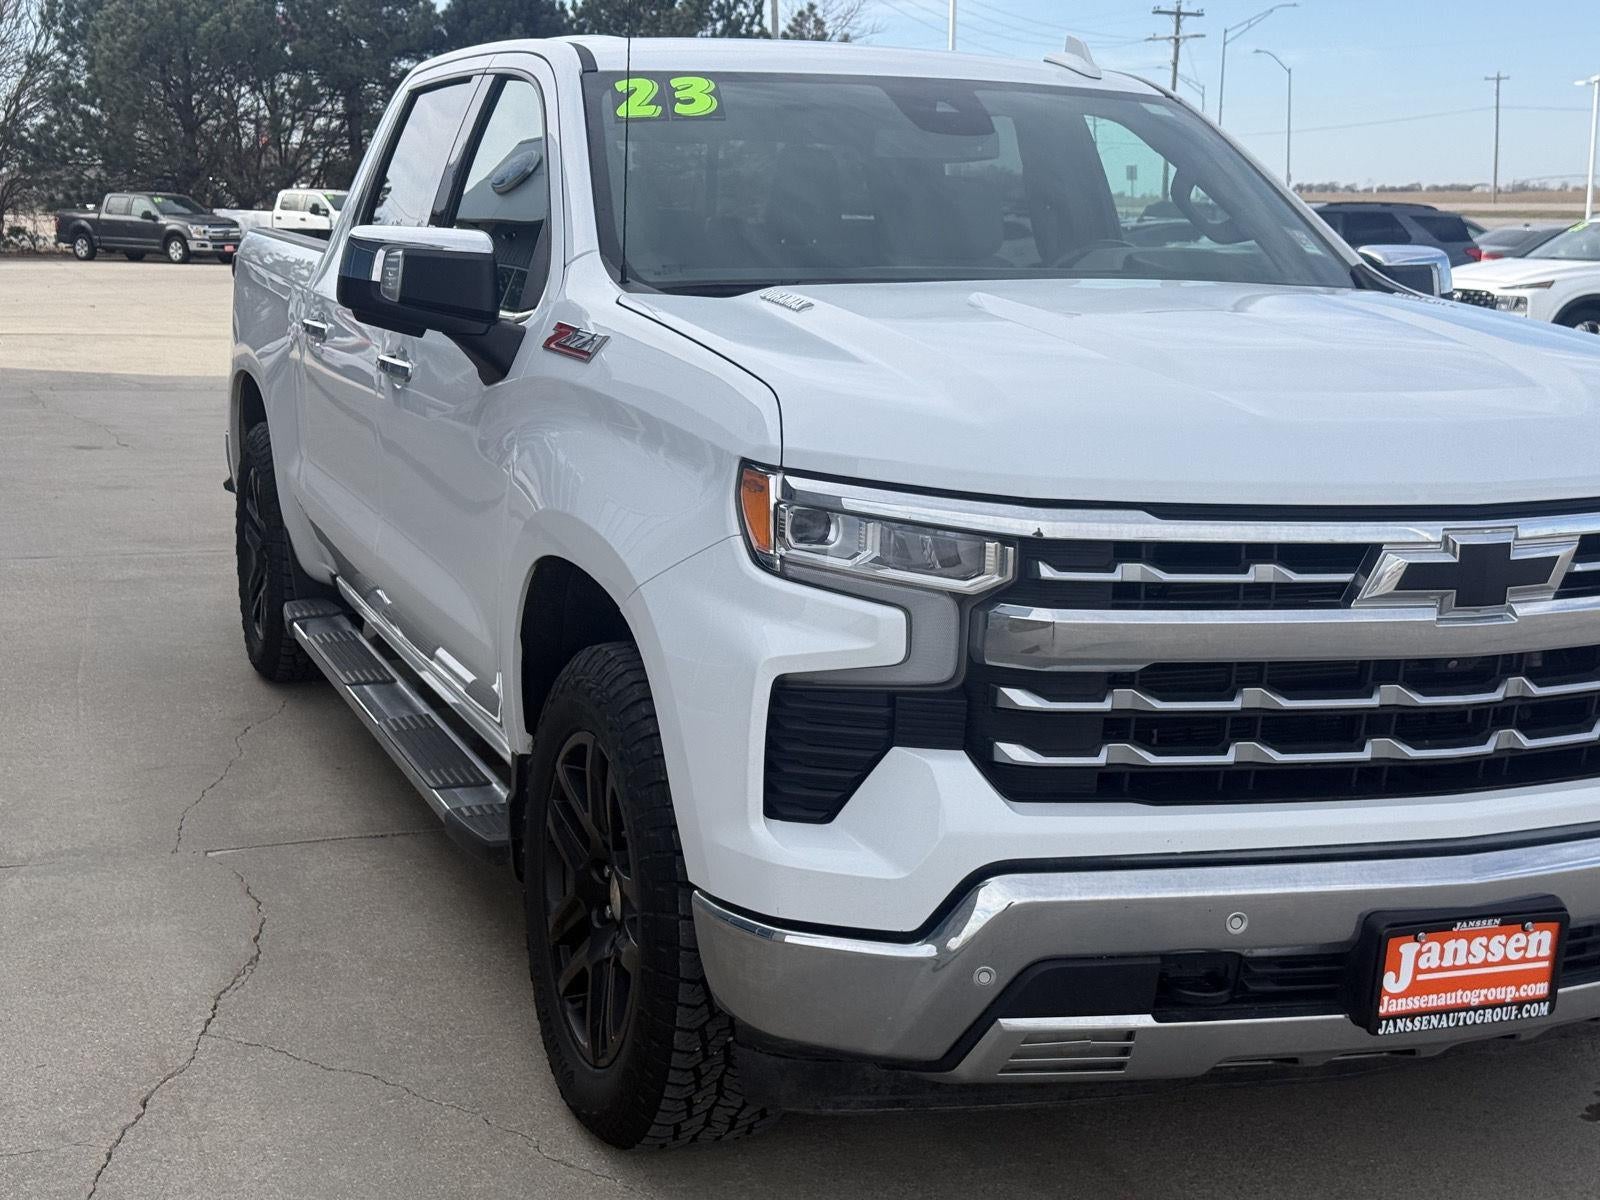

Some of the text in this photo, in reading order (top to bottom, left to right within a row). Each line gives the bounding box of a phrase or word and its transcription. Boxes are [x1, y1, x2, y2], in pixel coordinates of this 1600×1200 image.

[614, 76, 718, 118] 23
[542, 321, 610, 364] Z71
[1452, 917, 1501, 932] JANSSEN
[1382, 929, 1552, 994] Janssen
[1378, 980, 1549, 1014] Janssenautogroup.com
[1378, 1001, 1550, 1036] JANSSENAUTOGROUP.COM
